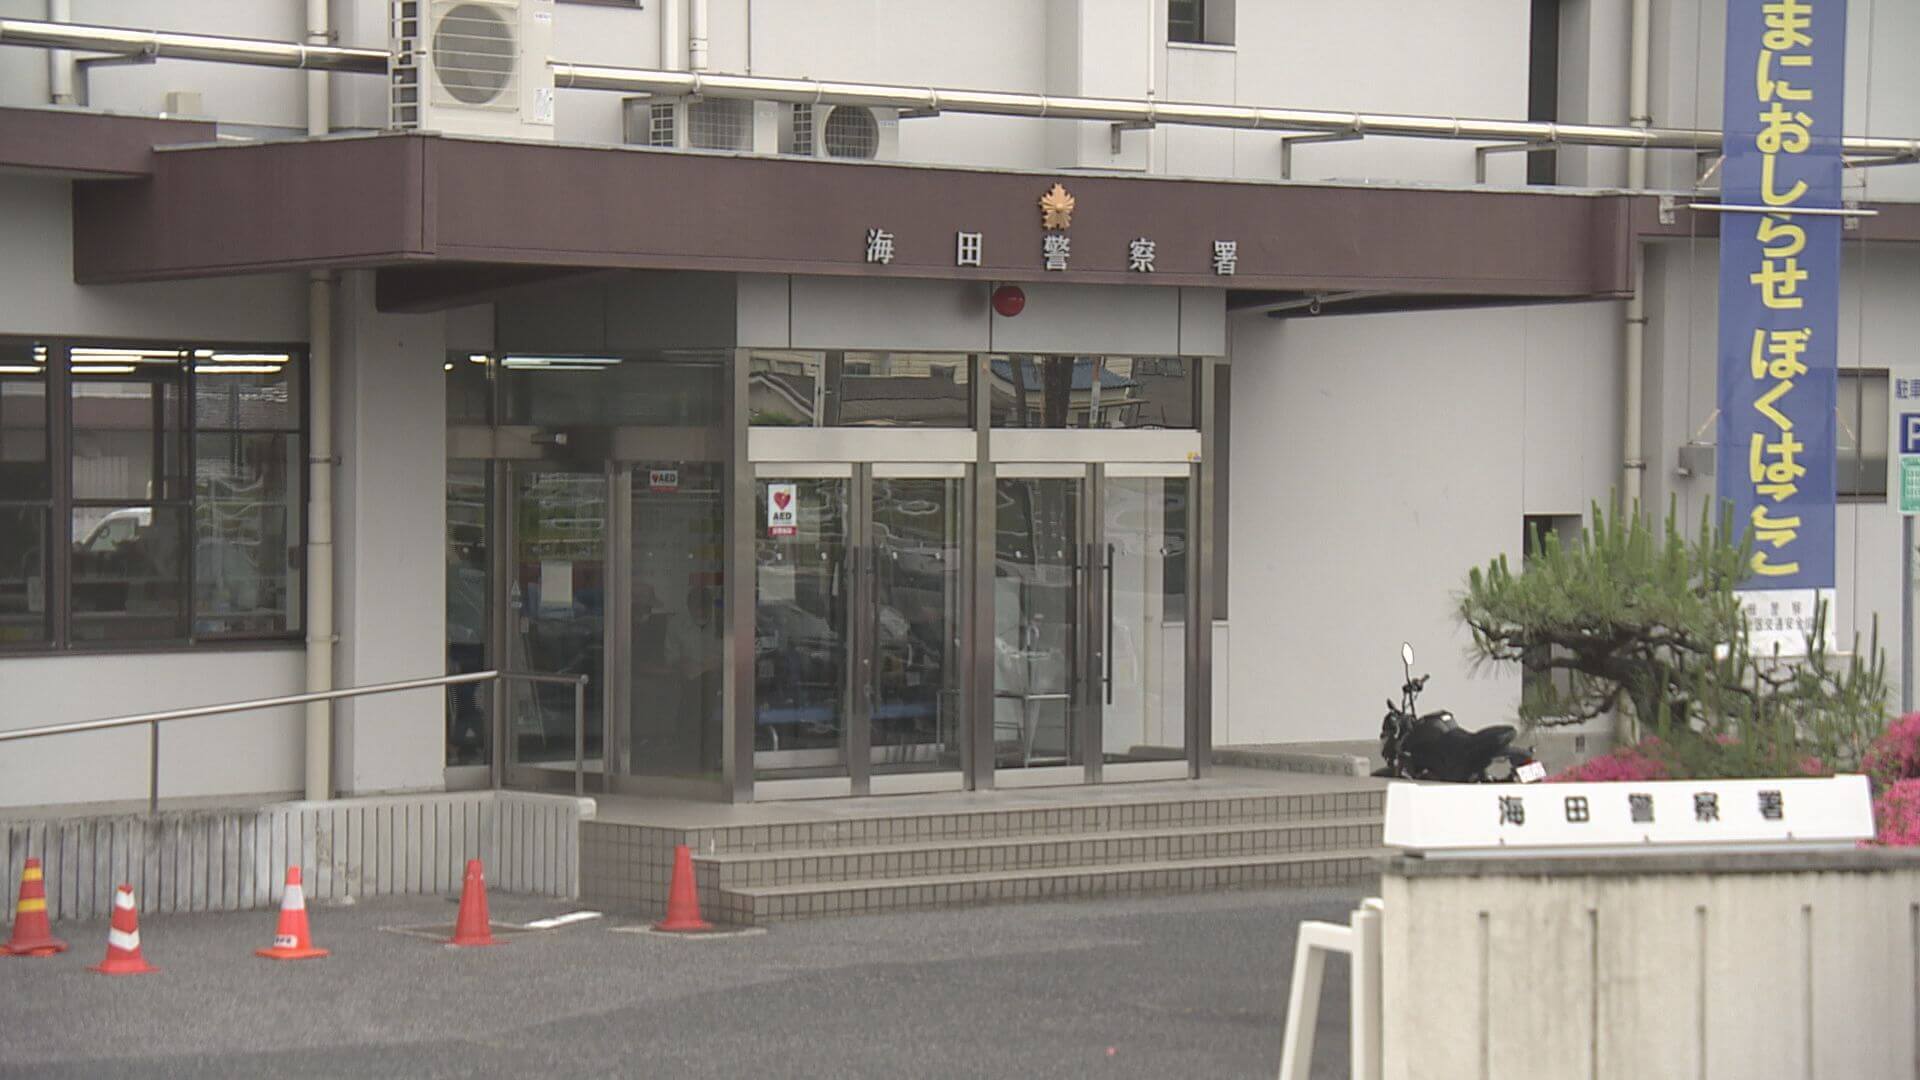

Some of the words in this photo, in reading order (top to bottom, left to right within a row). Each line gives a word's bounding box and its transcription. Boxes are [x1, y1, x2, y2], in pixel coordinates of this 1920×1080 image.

[866, 228, 1238, 276] 海田警察署
[1750, 328, 1812, 576] ぼくはここ
[658, 473, 676, 483] AED
[772, 511, 792, 521] AED
[1498, 789, 1783, 827] 海田警察署
